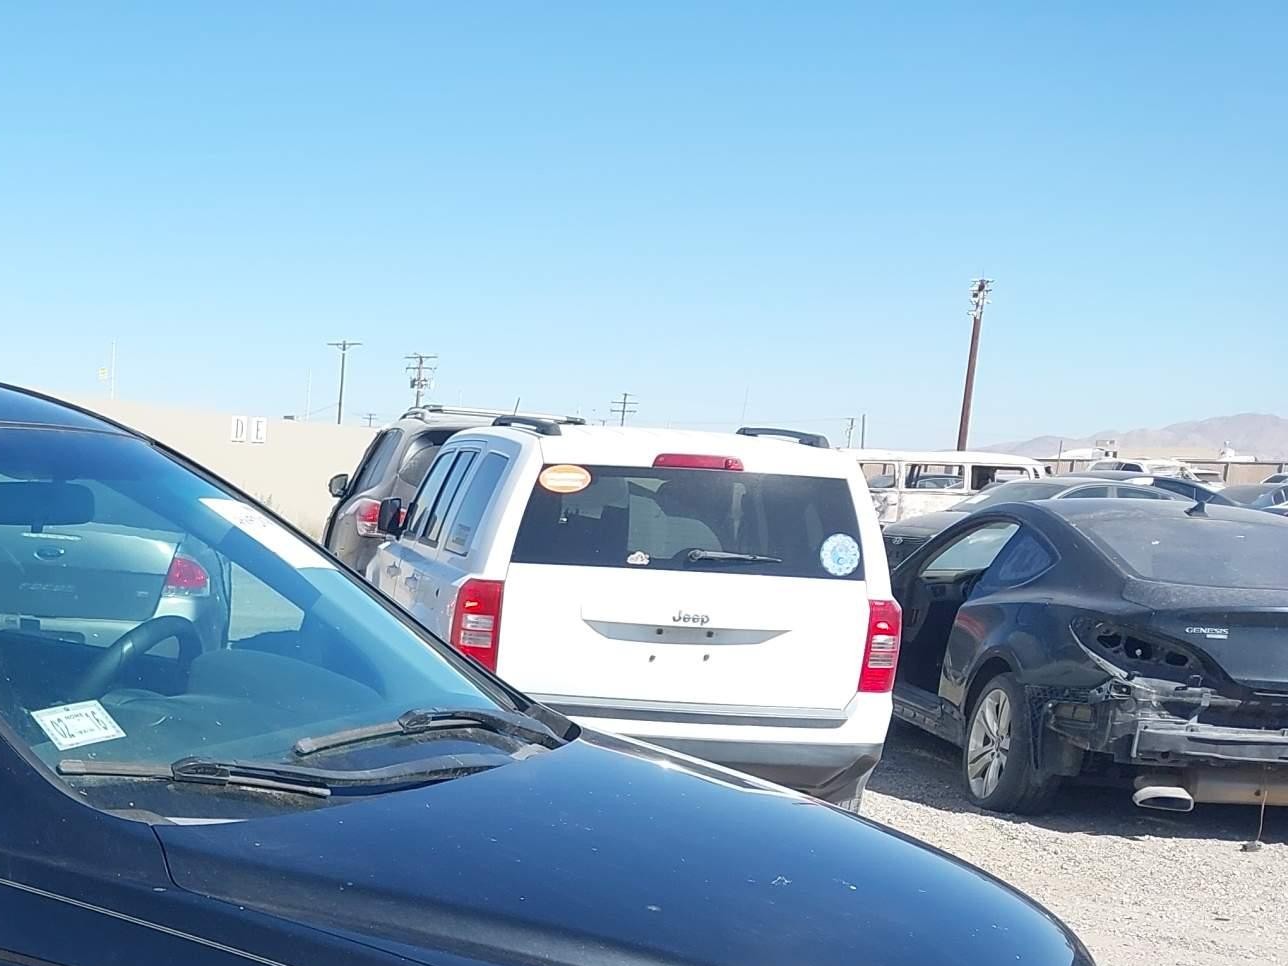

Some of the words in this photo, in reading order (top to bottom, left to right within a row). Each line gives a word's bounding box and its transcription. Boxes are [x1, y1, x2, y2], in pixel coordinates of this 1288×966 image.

[235, 418, 244, 438] D
[672, 609, 710, 626] Jeep
[1185, 626, 1229, 635] GENESIS
